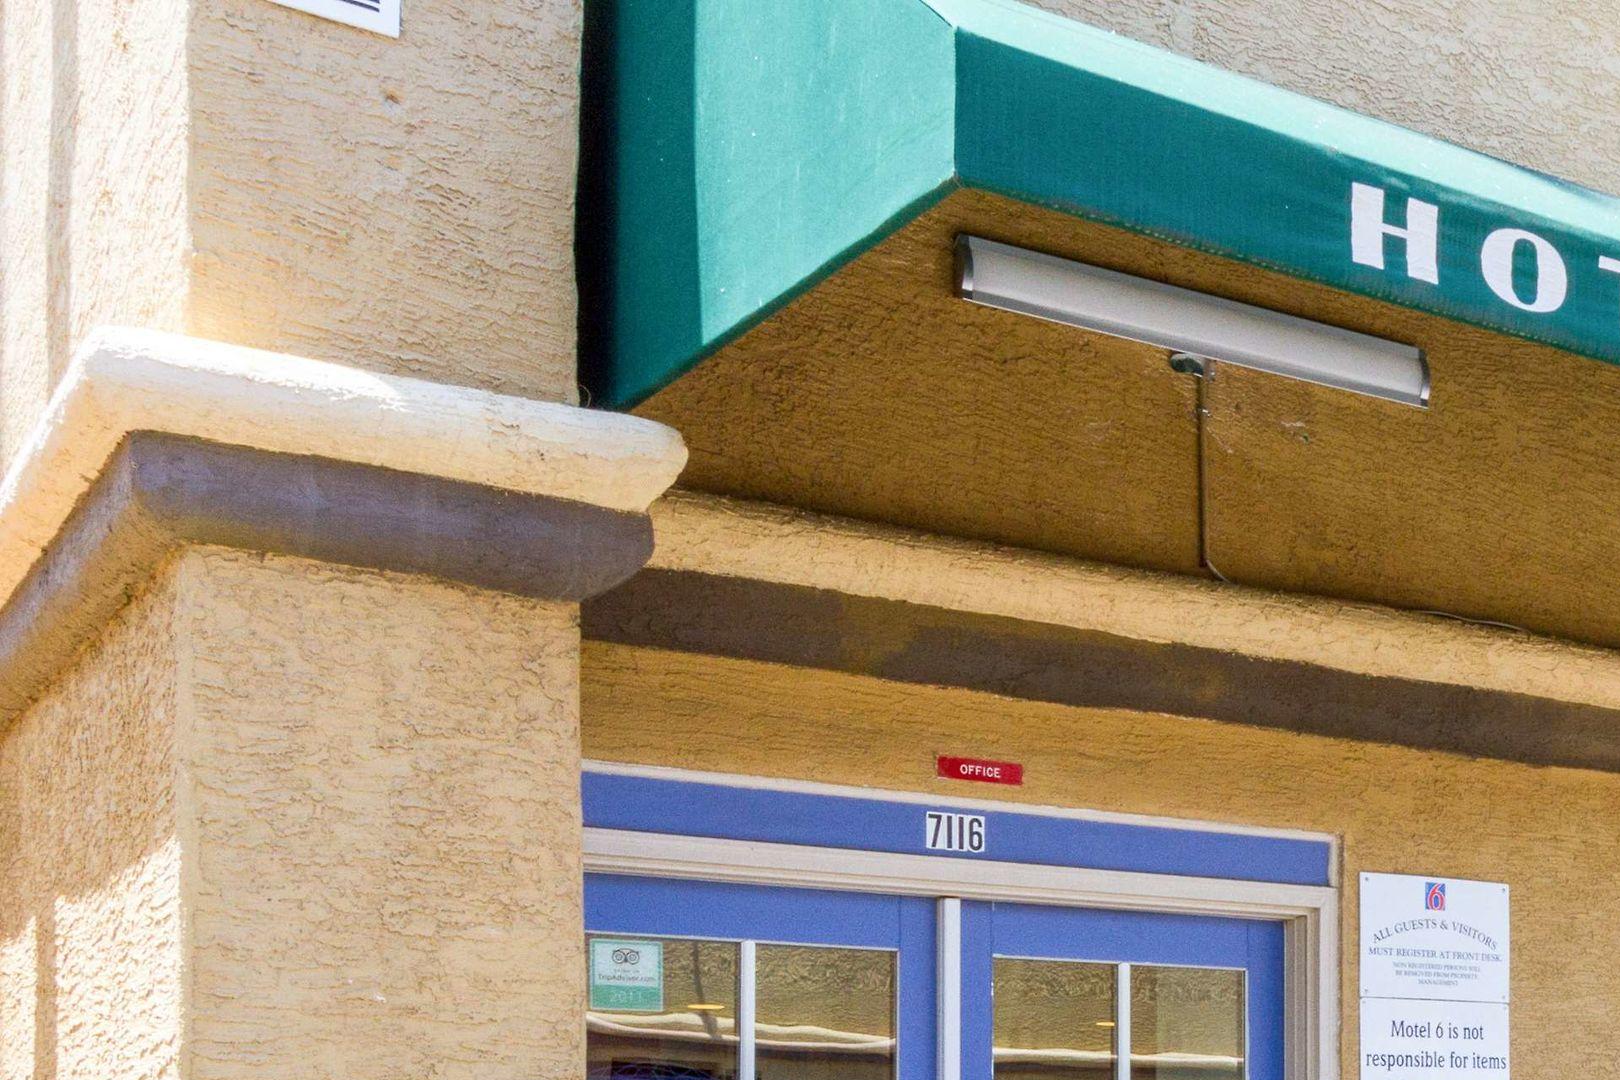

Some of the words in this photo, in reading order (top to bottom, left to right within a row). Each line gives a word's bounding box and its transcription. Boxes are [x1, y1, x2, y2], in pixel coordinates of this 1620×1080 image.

[960, 764, 1001, 778] OFFICE
[927, 813, 983, 851] 7116
[1427, 882, 1446, 911] 6
[1373, 927, 1393, 944] ALL
[1394, 919, 1438, 934] GUESTS
[1440, 920, 1449, 931] &
[1452, 922, 1499, 951] VISITORS
[1368, 947, 1394, 957] MUST
[1396, 948, 1437, 959] REGISTER
[1439, 950, 1452, 960] AT
[1452, 951, 1480, 961] FRONT
[1390, 1020, 1431, 1038] Motel
[1435, 1022, 1444, 1039] 6
[1448, 1022, 1459, 1039] is
[1463, 1026, 1484, 1040] not
[1366, 1051, 1445, 1071] responsible
[1450, 1051, 1468, 1069] for
[1472, 1052, 1507, 1070] items
